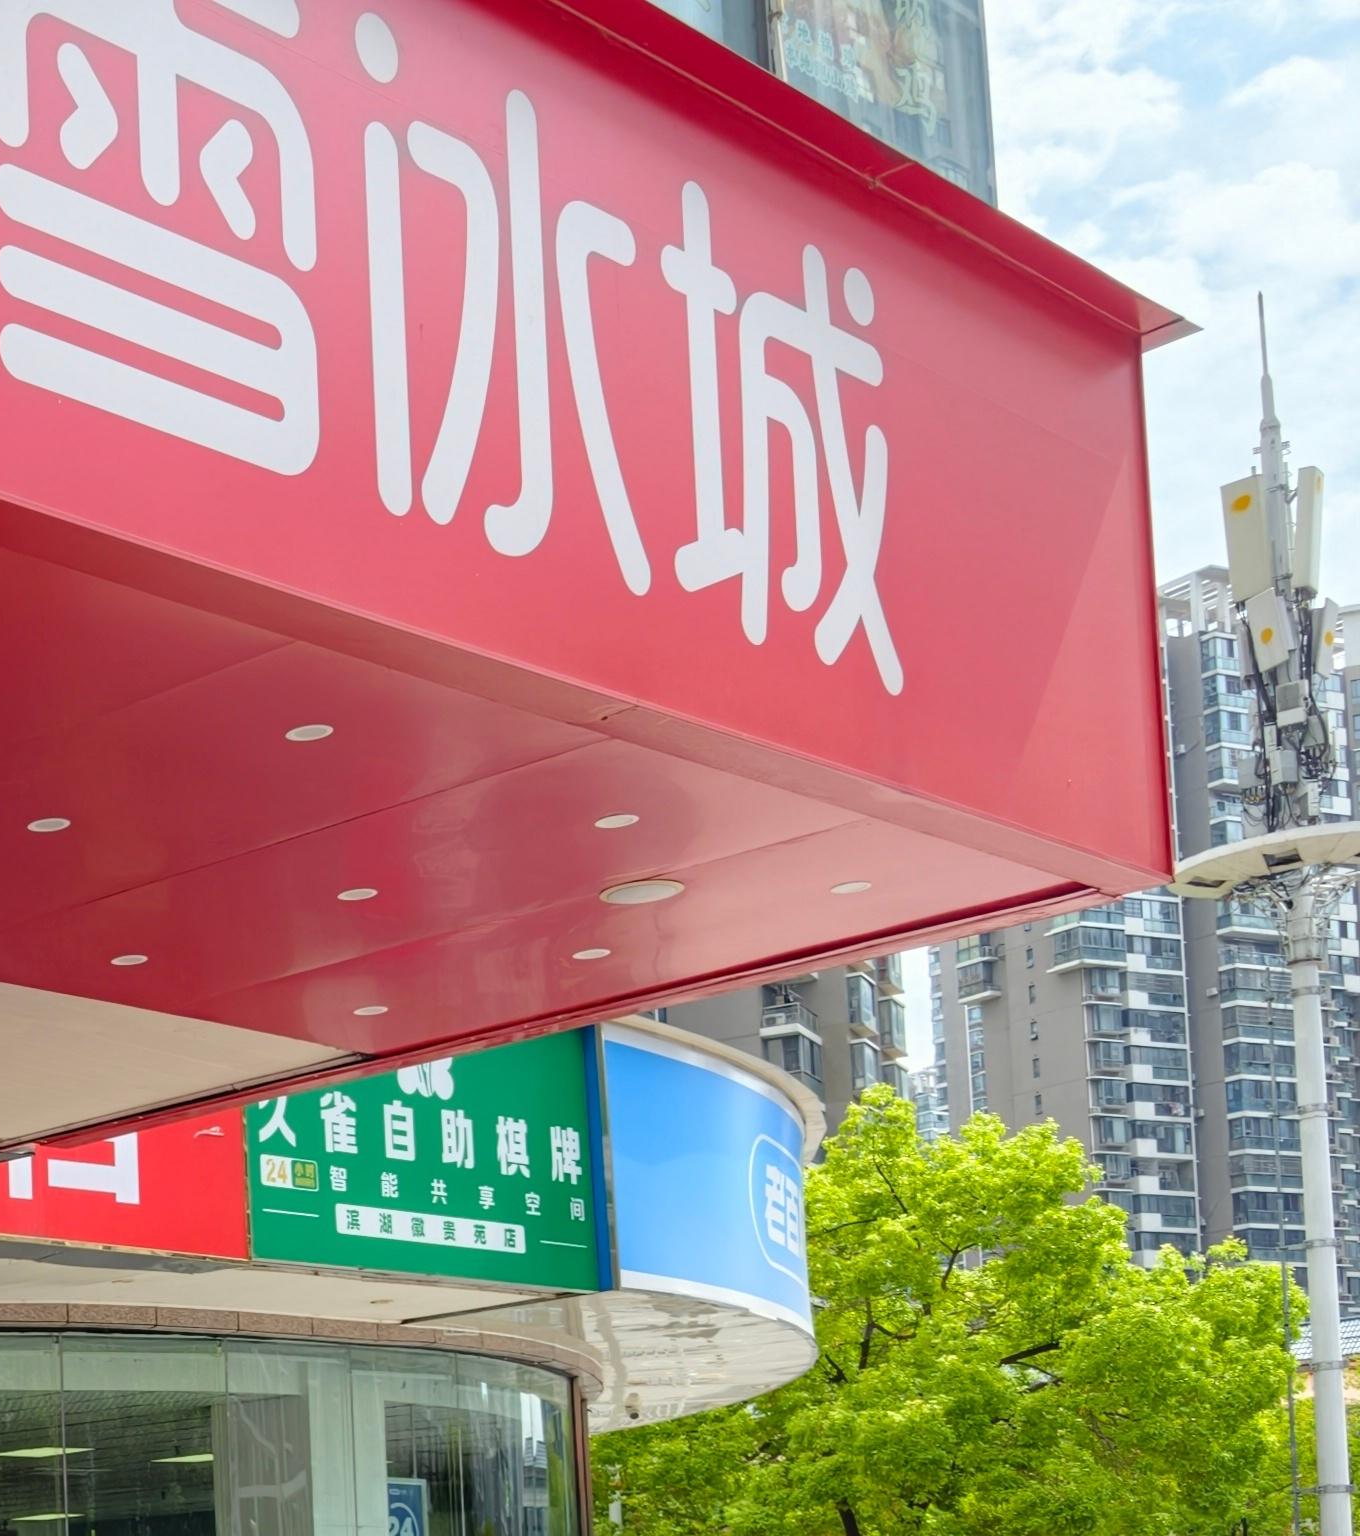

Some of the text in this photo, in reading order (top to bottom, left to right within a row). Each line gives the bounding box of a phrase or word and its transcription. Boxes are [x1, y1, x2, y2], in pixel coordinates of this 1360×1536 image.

[265, 1158, 288, 1184] 24
[329, 1165, 585, 1222] 智能共享空间
